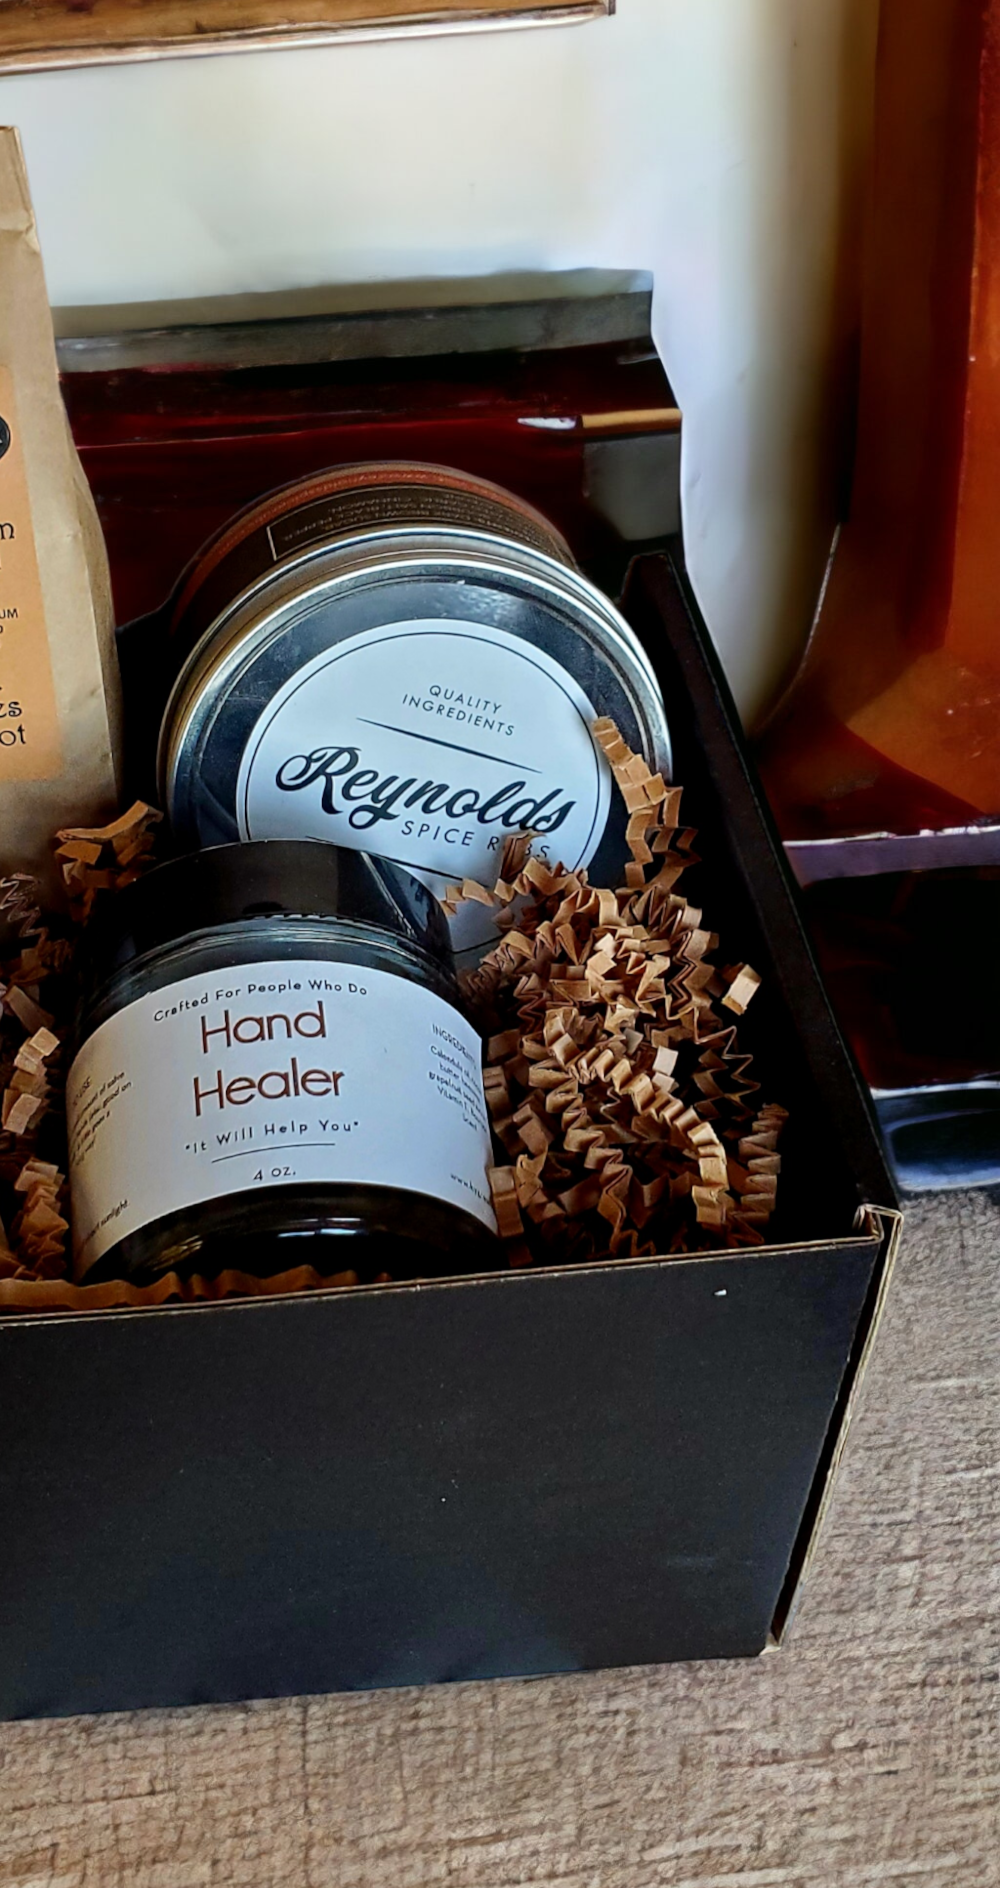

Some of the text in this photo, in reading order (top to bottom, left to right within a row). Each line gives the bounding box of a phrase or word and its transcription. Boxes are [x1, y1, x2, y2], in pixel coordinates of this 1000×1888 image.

[402, 694, 515, 736] INGREDIENTS
[429, 685, 502, 714] QUALITY
[275, 746, 577, 832] Reynolds
[401, 820, 475, 846] SPICE
[154, 979, 368, 1022] Crafted For People Who Do
[200, 1000, 327, 1054] Hand
[192, 1056, 346, 1118] Healer
[216, 1126, 253, 1145] Will
[264, 1120, 308, 1135] Help
[253, 1169, 264, 1181] 4
